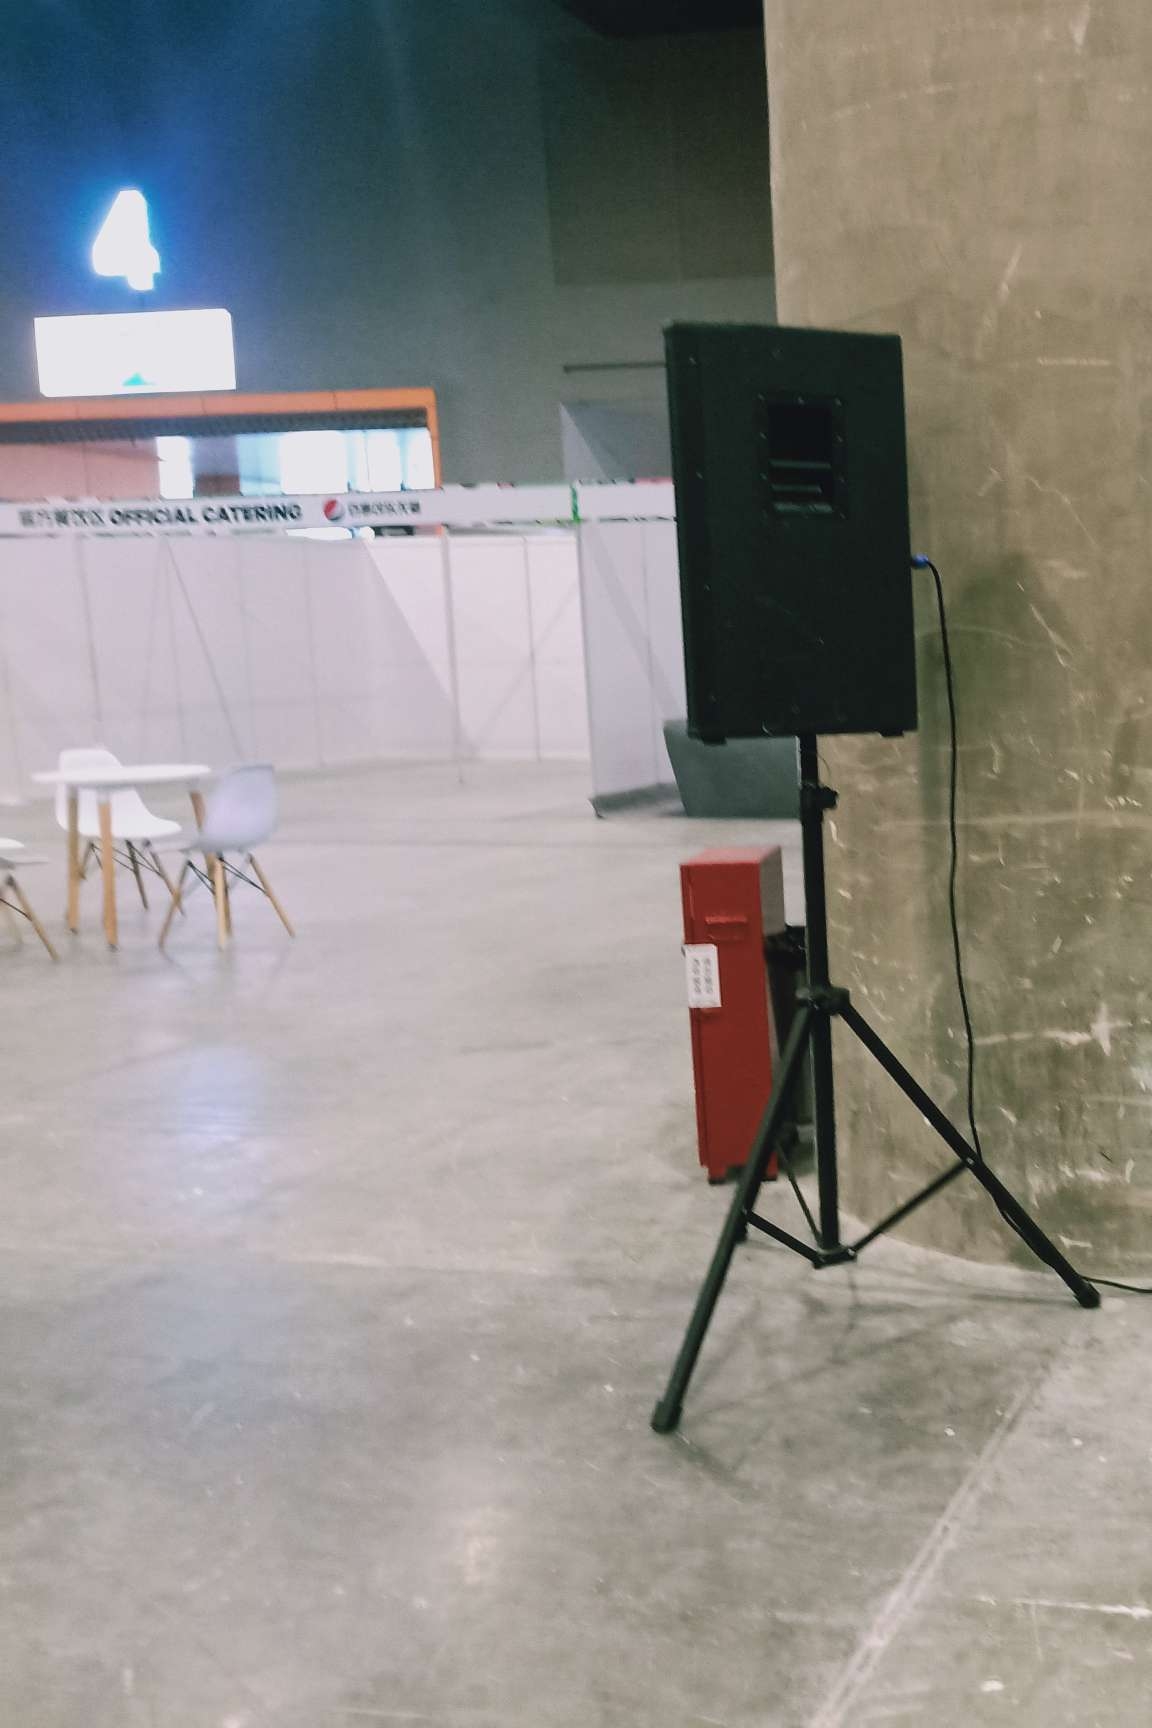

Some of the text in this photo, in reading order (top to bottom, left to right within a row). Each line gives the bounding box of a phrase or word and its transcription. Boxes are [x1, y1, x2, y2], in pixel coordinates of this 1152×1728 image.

[92, 189, 161, 290] 4
[109, 508, 199, 524] OFFICIAL
[202, 505, 303, 523] CATERING
